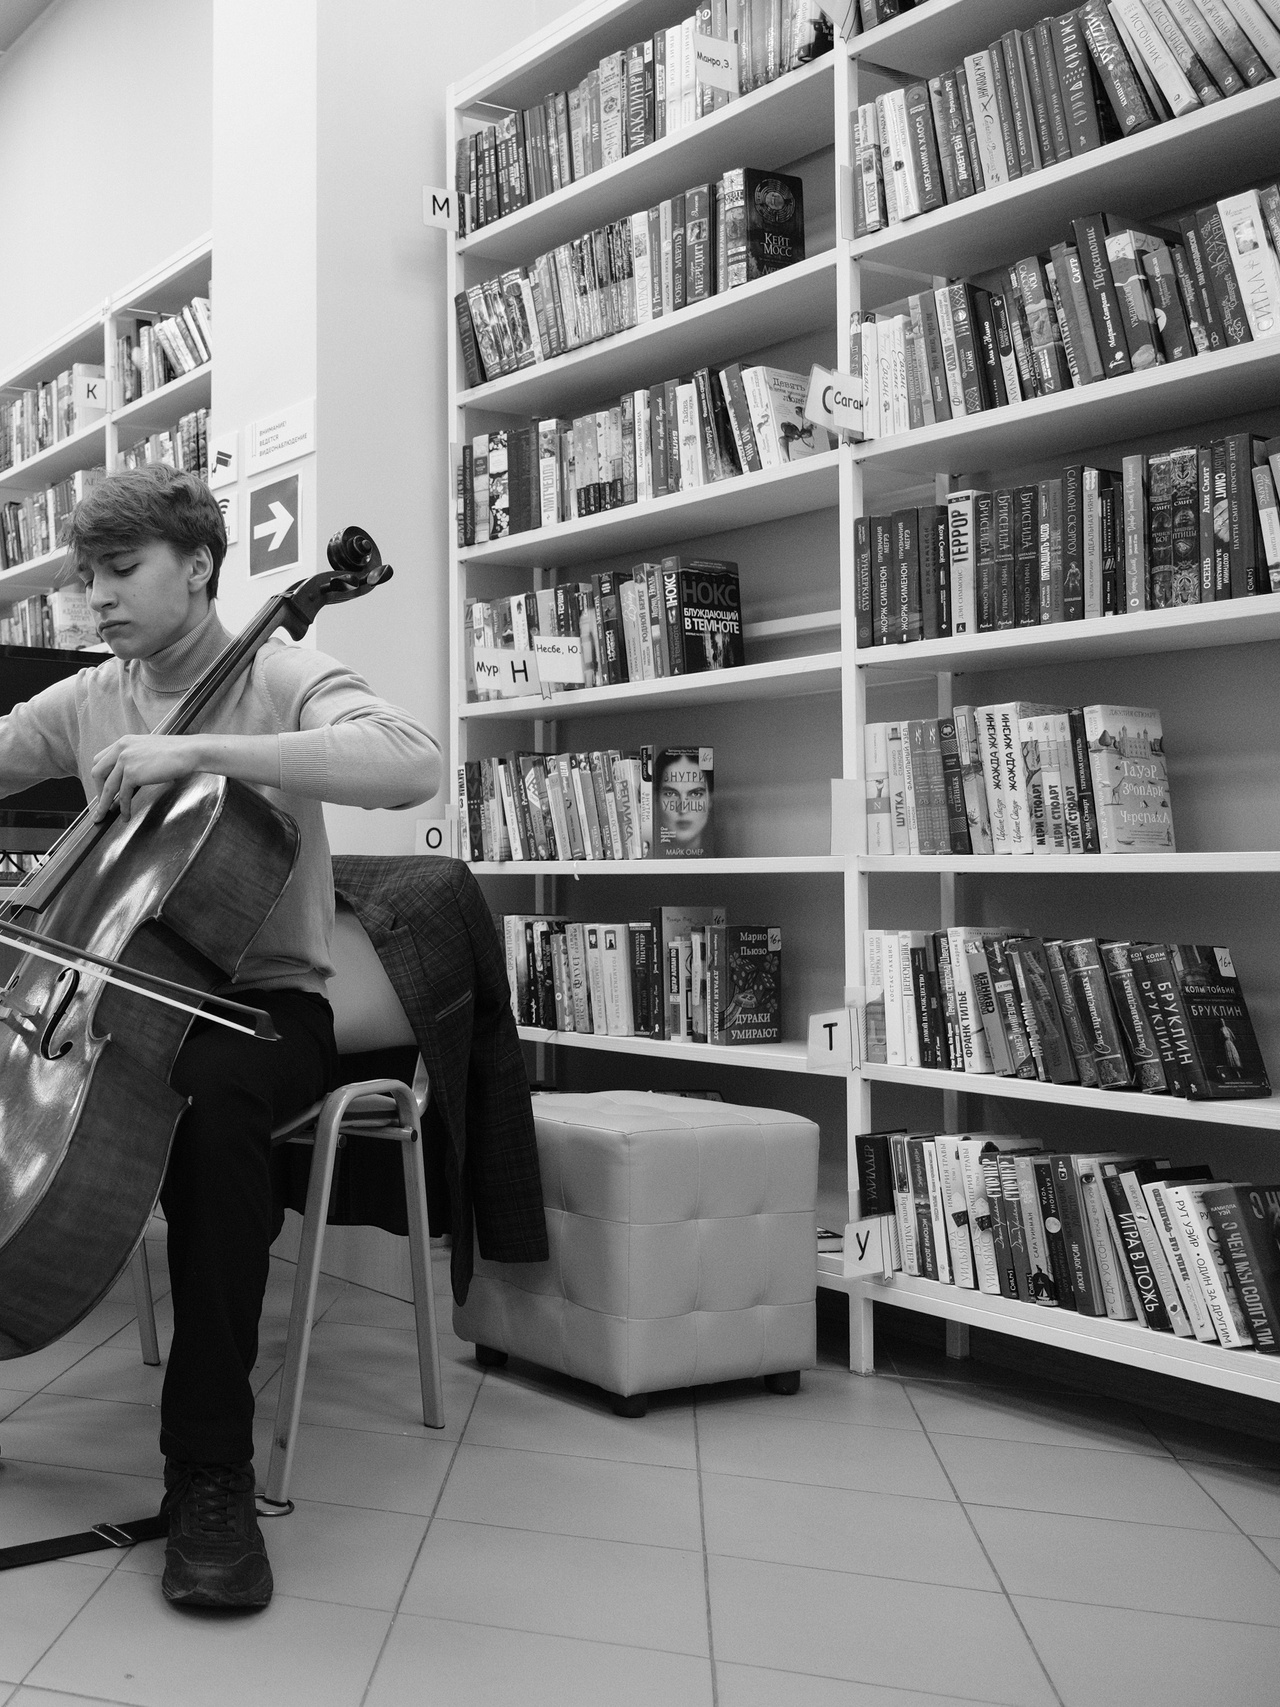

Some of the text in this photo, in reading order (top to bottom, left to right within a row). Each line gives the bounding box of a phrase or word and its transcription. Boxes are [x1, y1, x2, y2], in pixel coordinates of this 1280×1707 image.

[1130, 13, 1163, 64] ИСТОЧНИК
[1154, 8, 1187, 58] ИСТОЧНИК
[1207, 4, 1231, 37] ЖИВЫЕ
[630, 81, 645, 148] МАКЛИН
[1015, 109, 1027, 156] САЛЛИ РУНИ
[915, 115, 933, 192] МЕХАНИКА ХАОСА
[1002, 121, 1015, 166] САЛЛИ РУНИ
[432, 194, 450, 218] М
[760, 243, 792, 257] МОСС
[764, 232, 790, 247] КЕЙТ
[674, 235, 682, 304] РОБЕР МЕРЛЬ
[694, 244, 706, 294] МЕРЕДИТ
[1070, 257, 1082, 283] САРТР
[1086, 226, 1117, 348] Маржан Сатрапи Персеполис
[1247, 270, 1275, 332] СИГАЛ
[86, 383, 98, 400] К
[672, 430, 680, 461] БИЛЕТ
[741, 428, 754, 462] МО ЯНЬ
[1087, 493, 1095, 513] НЯНЯ
[1173, 499, 1194, 507] СМИТ
[1215, 473, 1227, 498] СМИТ
[979, 499, 991, 554] БРИСЕИДА
[997, 493, 1011, 551] БРИСЕИДА
[1020, 490, 1033, 549] БРИСЕИДА
[1066, 469, 1077, 556] САЙМОН СКЭРРОУ
[1202, 466, 1211, 589] ОСЕНЬ Али Смит
[950, 510, 969, 566] ТЕРРОР
[1232, 524, 1240, 550] ПАТТИ
[664, 574, 677, 602] НОКС
[683, 579, 738, 607] НОКС
[880, 566, 888, 633] ЖОРЖ СИМЕНОН
[900, 562, 908, 603] СИМЕНОН
[637, 589, 648, 642] РОДНОЙ БЕРЕГ
[683, 607, 739, 622] БЛУЖДАЮЩИЙ
[684, 617, 740, 635] В ТЕМНОТЕ
[477, 661, 499, 677] Мур
[511, 660, 529, 683] Н
[559, 761, 569, 777] ЦЕЛИ
[986, 713, 1002, 790] ЖАЖДА ЖИЗНИ
[1001, 713, 1017, 791] ЖАЖДА ЖИЗНИ
[664, 771, 706, 783] ВНУТРИ
[620, 780, 633, 842] РЕПЛИКА
[663, 800, 706, 812] УБИЙЦЫ
[895, 790, 905, 827] ШУТКА
[1032, 783, 1046, 846] МЕРИ СТЮАРТ
[1049, 784, 1064, 847] МЕРИ СТЮАРТ
[1066, 785, 1081, 849] МЕРИ СТЮАРТ
[426, 827, 442, 849] О
[665, 848, 685, 856] МАЙК
[505, 919, 514, 971] ОРХАН ПАМУК
[739, 932, 767, 943] Марио
[740, 947, 767, 956] Пьюзо
[919, 974, 930, 1044] ДОМОЙ НА РОЖДЕСТВО
[957, 991, 969, 1022] ТИЛЬЕ
[979, 972, 995, 1014] СВИНЕЙ
[1184, 984, 1236, 994] КОЛМ ТОЙБИН
[735, 1013, 771, 1026] ДУРАКИ
[1082, 976, 1111, 1053] Свет праведных
[1123, 979, 1153, 1057] Свет праведных
[1157, 981, 1193, 1064] БРУКЛИН
[1191, 1005, 1243, 1017] БРУКЛИН
[731, 1028, 778, 1040] УМИРАЮТ
[823, 1022, 838, 1051] Т
[961, 1025, 973, 1057] ФРАНК
[940, 1143, 953, 1208] ИМПЕРИЯ ТРАВЫ
[963, 1148, 977, 1213] ИМПЕРИЯ ТРАВЫ
[1045, 1178, 1056, 1214] КАТРИОНА
[855, 1230, 870, 1261] У
[922, 1218, 932, 1272] ИСТОРИЯ ДОЖДЯ
[1028, 1212, 1039, 1258] САРА УИНМАН
[1119, 1213, 1141, 1249] ИГРА
[957, 1230, 970, 1281] УИЛЬЯМС
[981, 1237, 997, 1288] УИЛЬЯМС
[1130, 1251, 1145, 1261] В
[1175, 1200, 1232, 1344] РУТ УЭЙР ОДИН ЗА ДРУГИМ
[1133, 1264, 1160, 1313] ЛОЖЬ
[1221, 1222, 1275, 1347] О ЧЕМ МЫ СОЛГАЛИ
